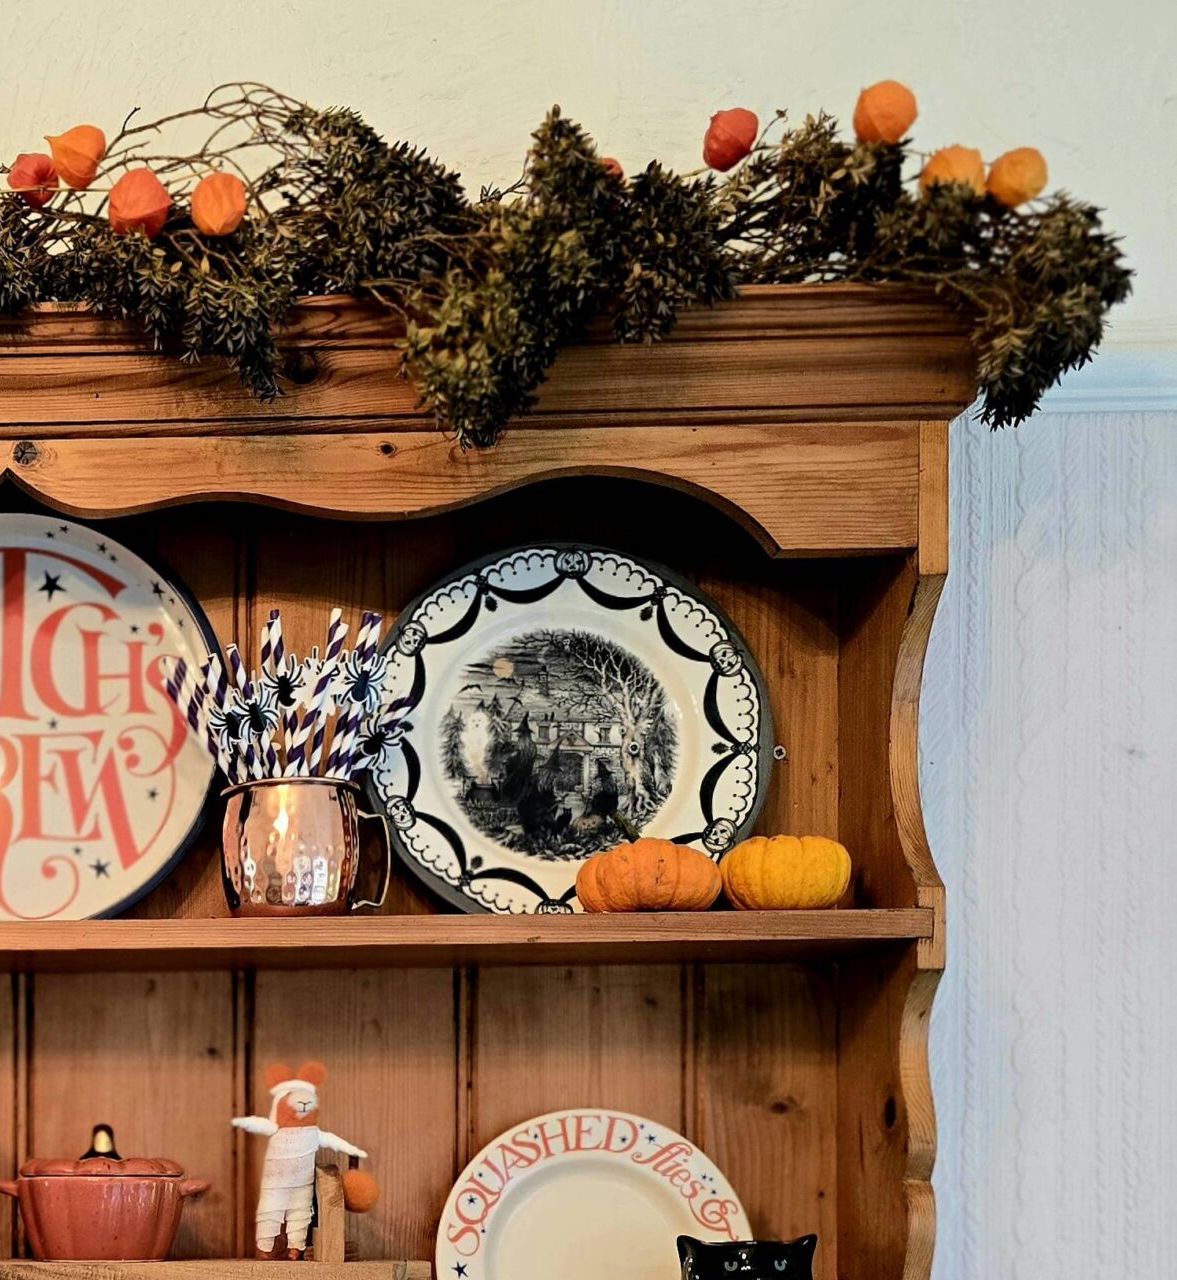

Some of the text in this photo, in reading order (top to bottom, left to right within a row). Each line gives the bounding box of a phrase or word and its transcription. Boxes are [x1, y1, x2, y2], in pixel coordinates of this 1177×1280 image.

[447, 1114, 739, 1256] SQUASHED flies &
